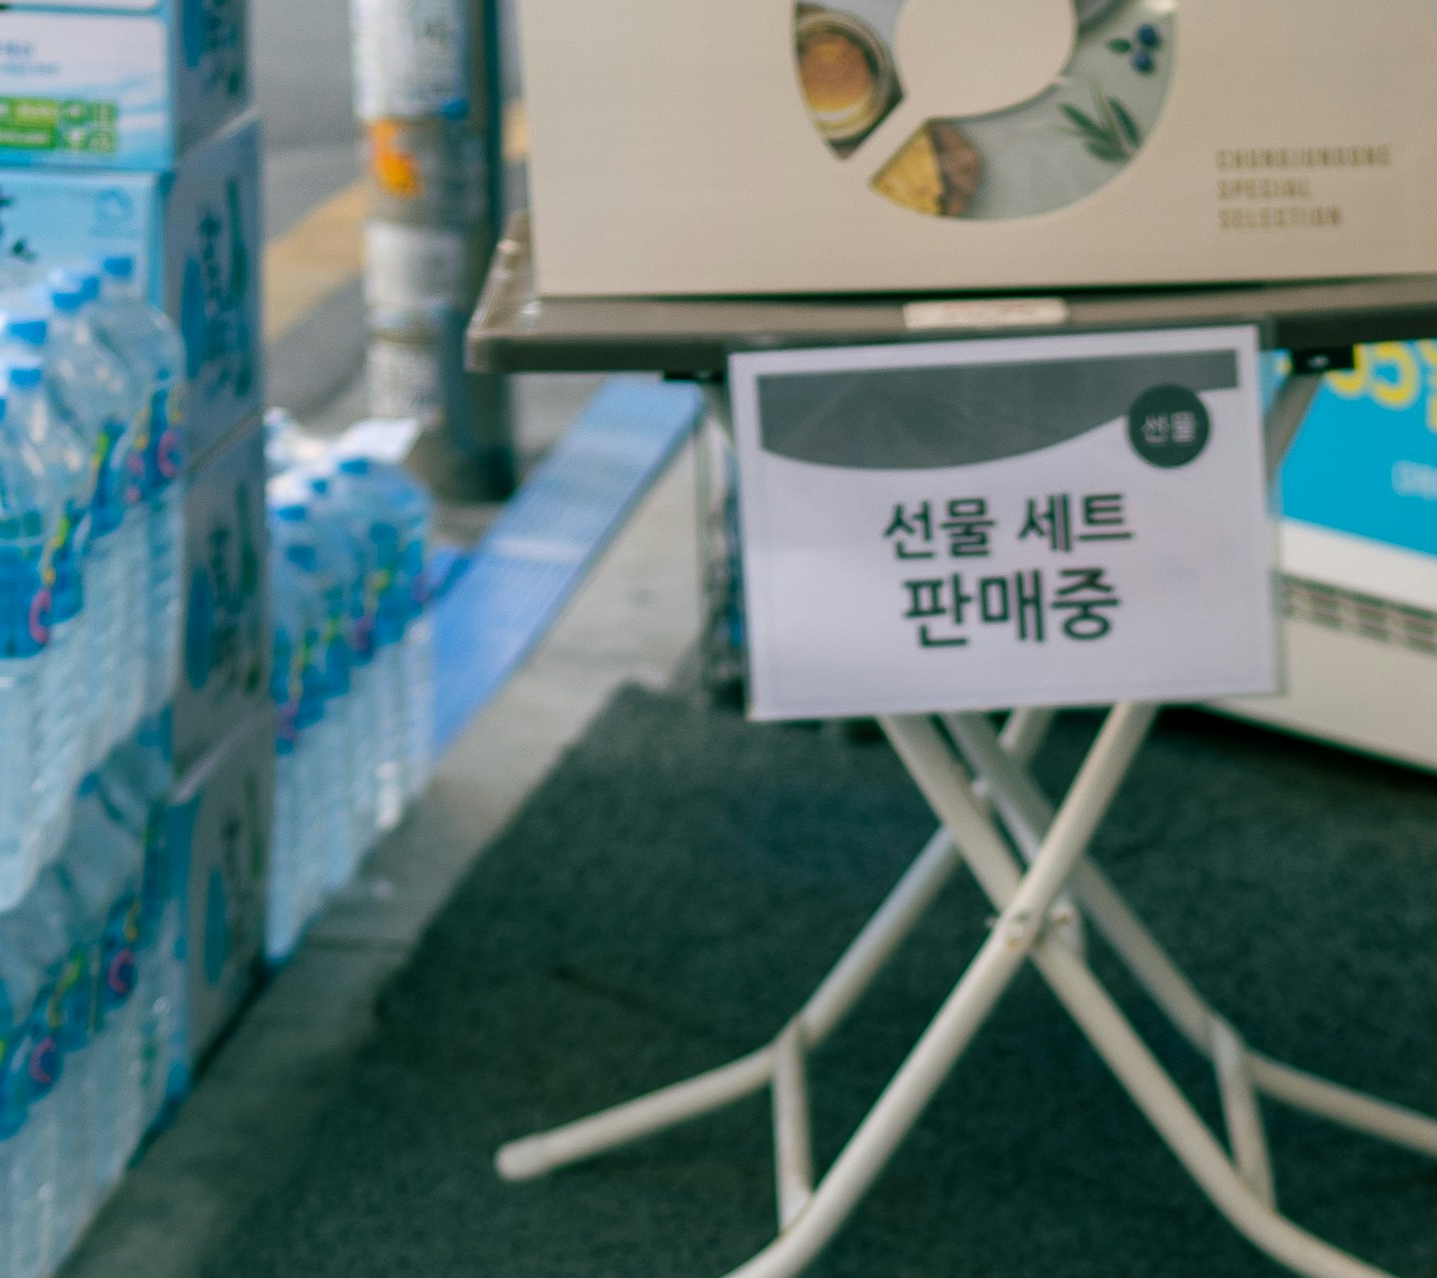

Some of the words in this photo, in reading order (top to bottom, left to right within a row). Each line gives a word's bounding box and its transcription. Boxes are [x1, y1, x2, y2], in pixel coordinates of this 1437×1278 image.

[883, 498, 996, 560] 선물
[1018, 493, 1135, 554] 세트
[903, 567, 1121, 648] 판매중
